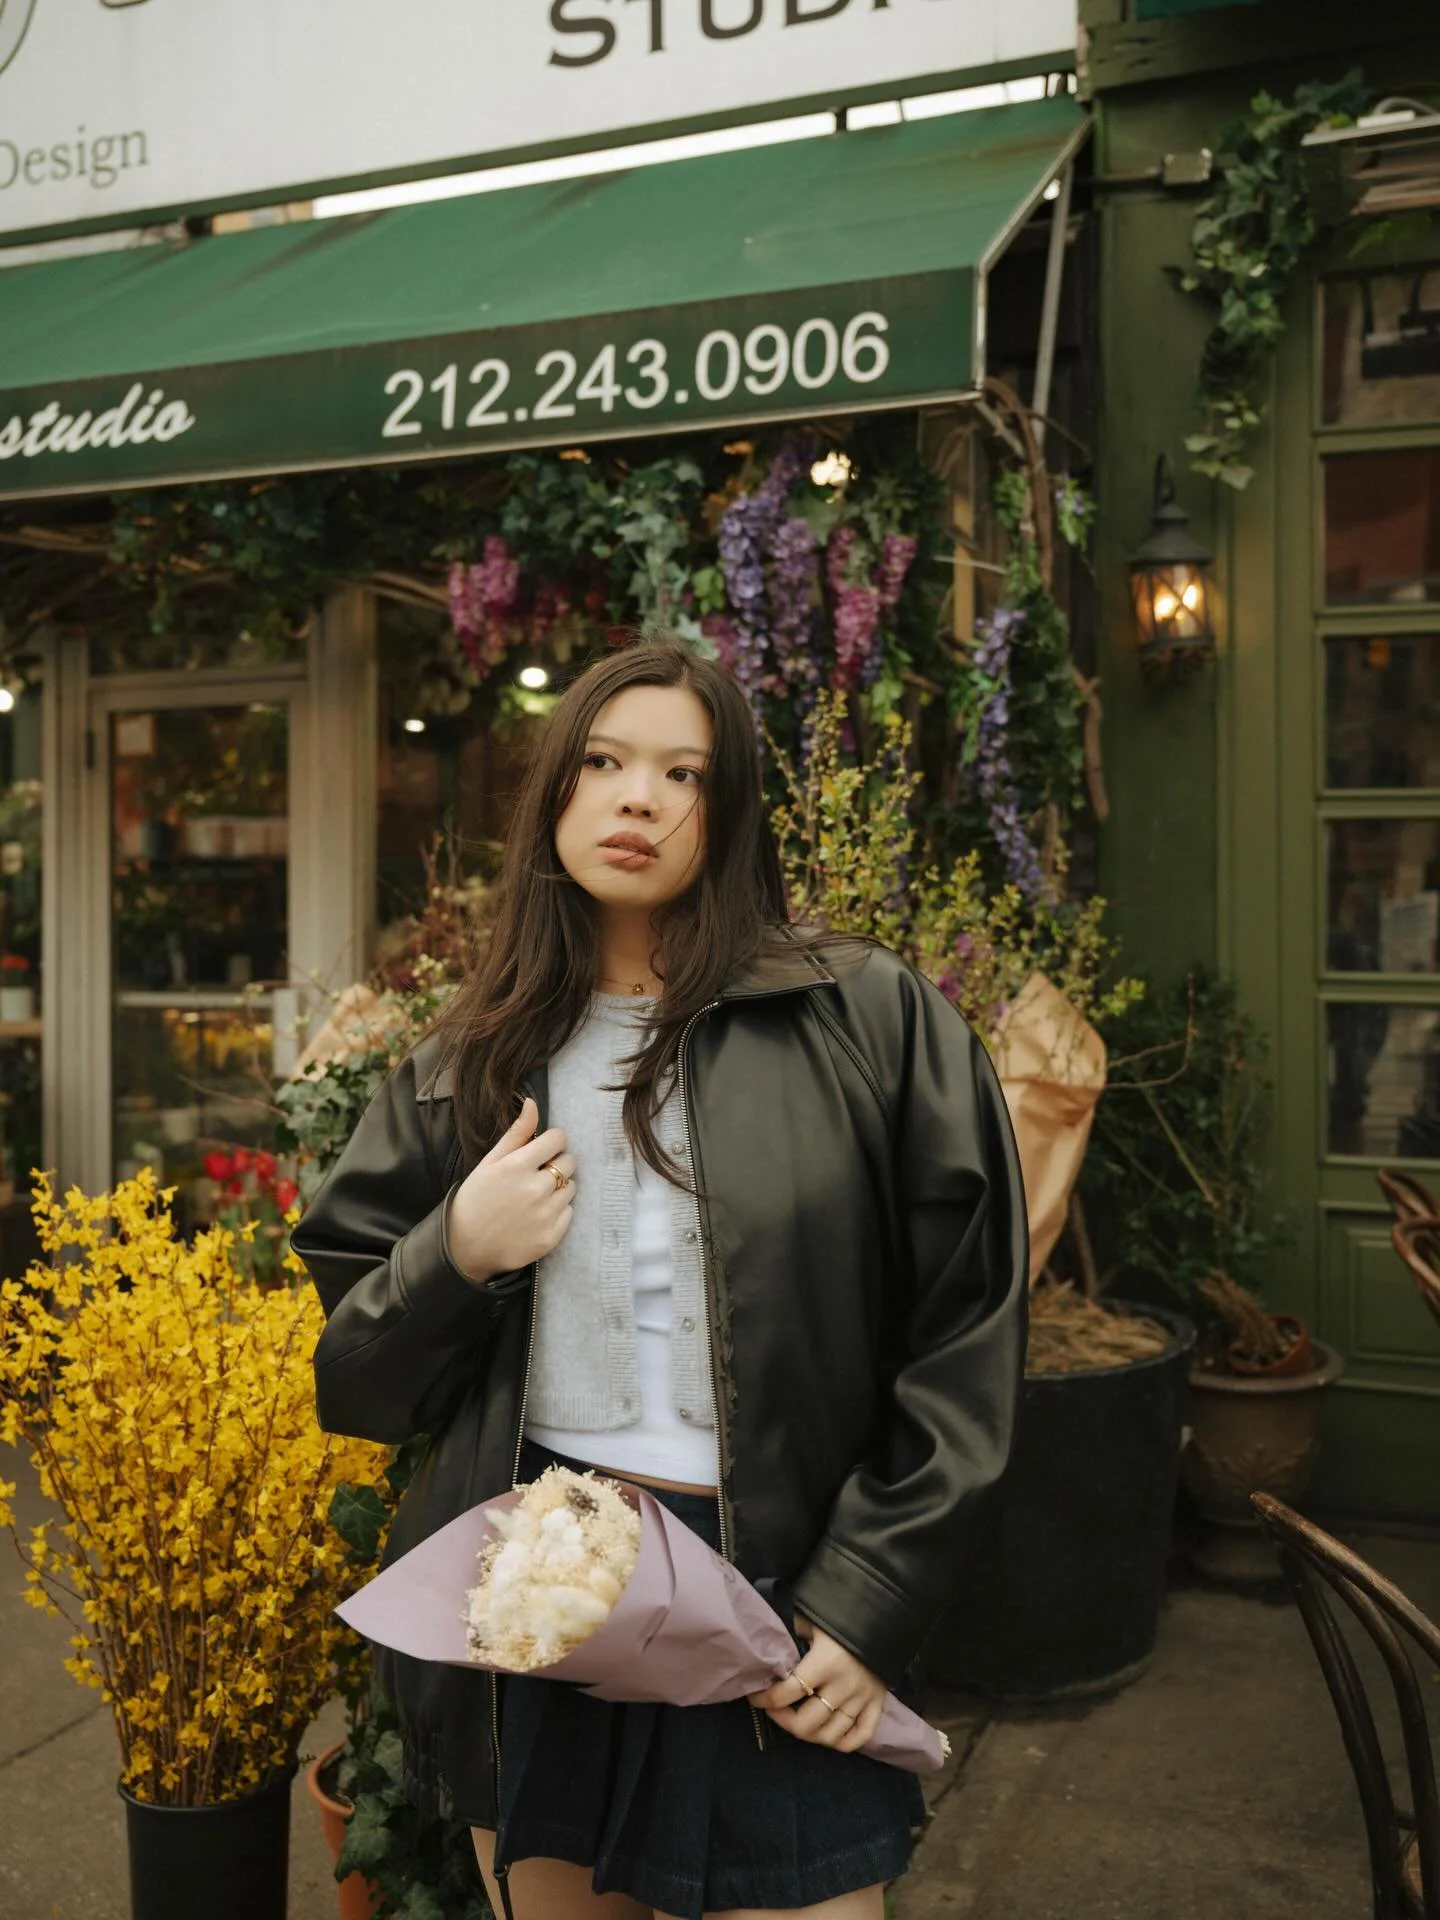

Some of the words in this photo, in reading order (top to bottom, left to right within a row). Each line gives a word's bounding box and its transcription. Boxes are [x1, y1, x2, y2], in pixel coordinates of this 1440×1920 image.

[548, 0, 942, 68] STU
[381, 311, 890, 438] 212.243.0906
[0, 382, 196, 459] studio
